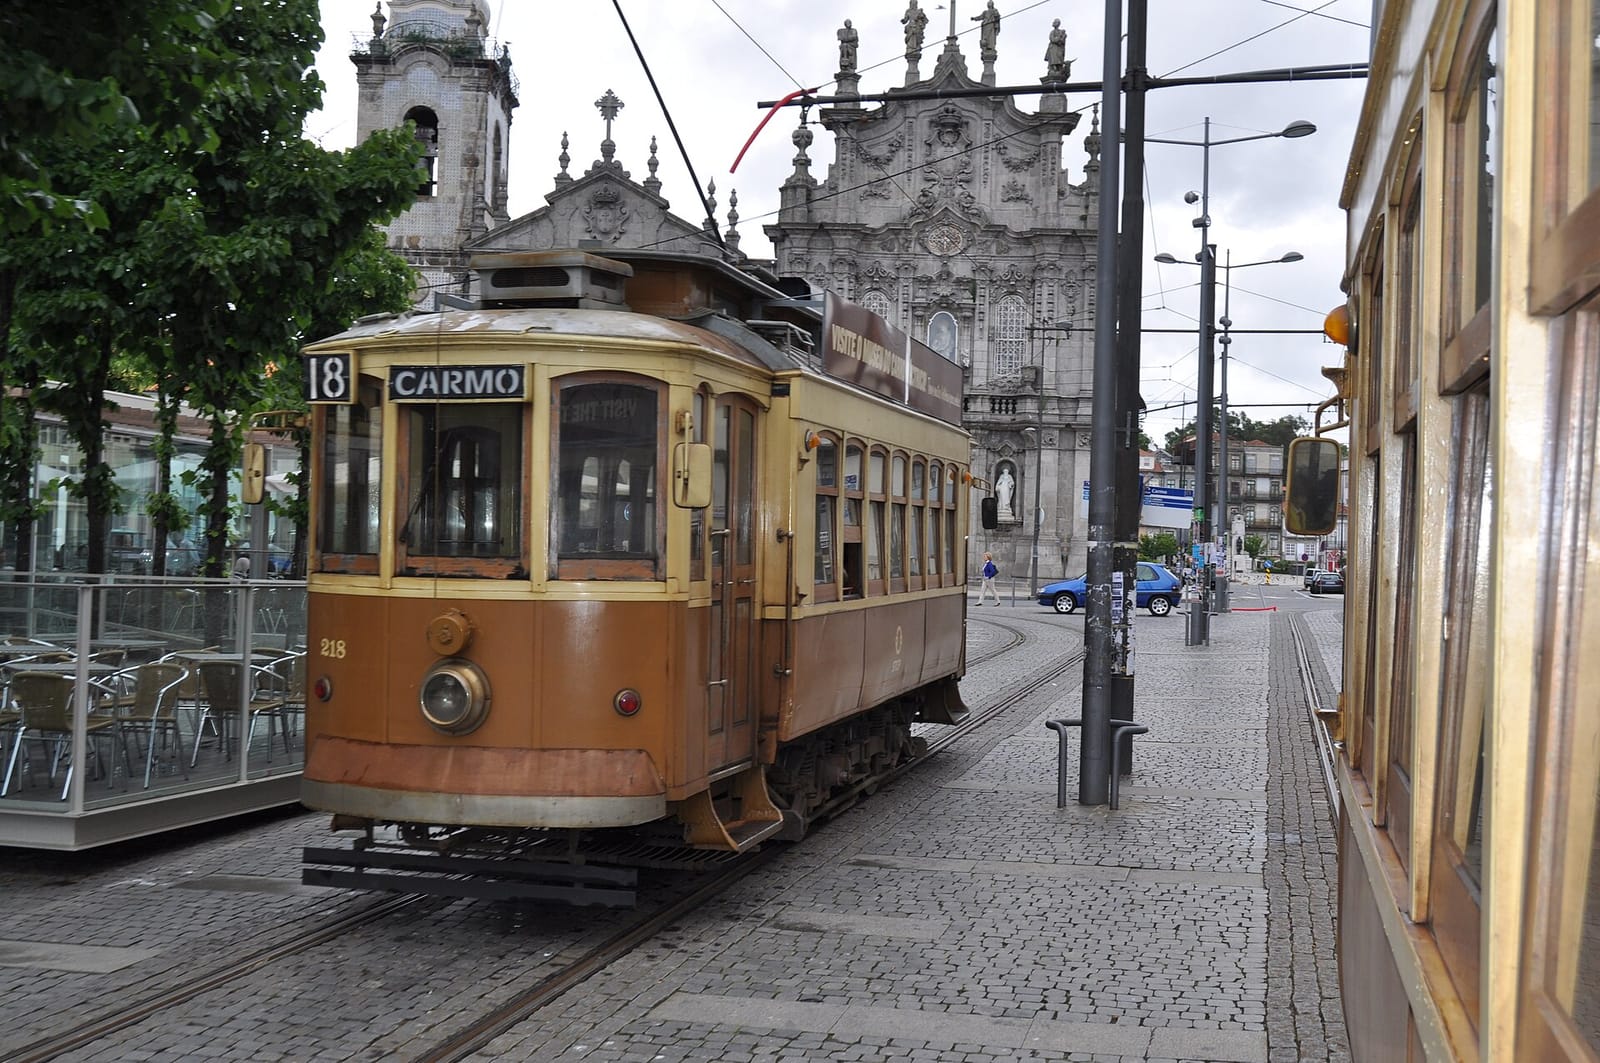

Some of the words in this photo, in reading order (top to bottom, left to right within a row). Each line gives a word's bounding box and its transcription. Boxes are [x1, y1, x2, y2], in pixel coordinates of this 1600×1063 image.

[832, 323, 857, 358] VISITE
[857, 335, 863, 361] O
[309, 357, 346, 400] 18
[395, 369, 520, 396] CARMO
[320, 638, 346, 659] 218
